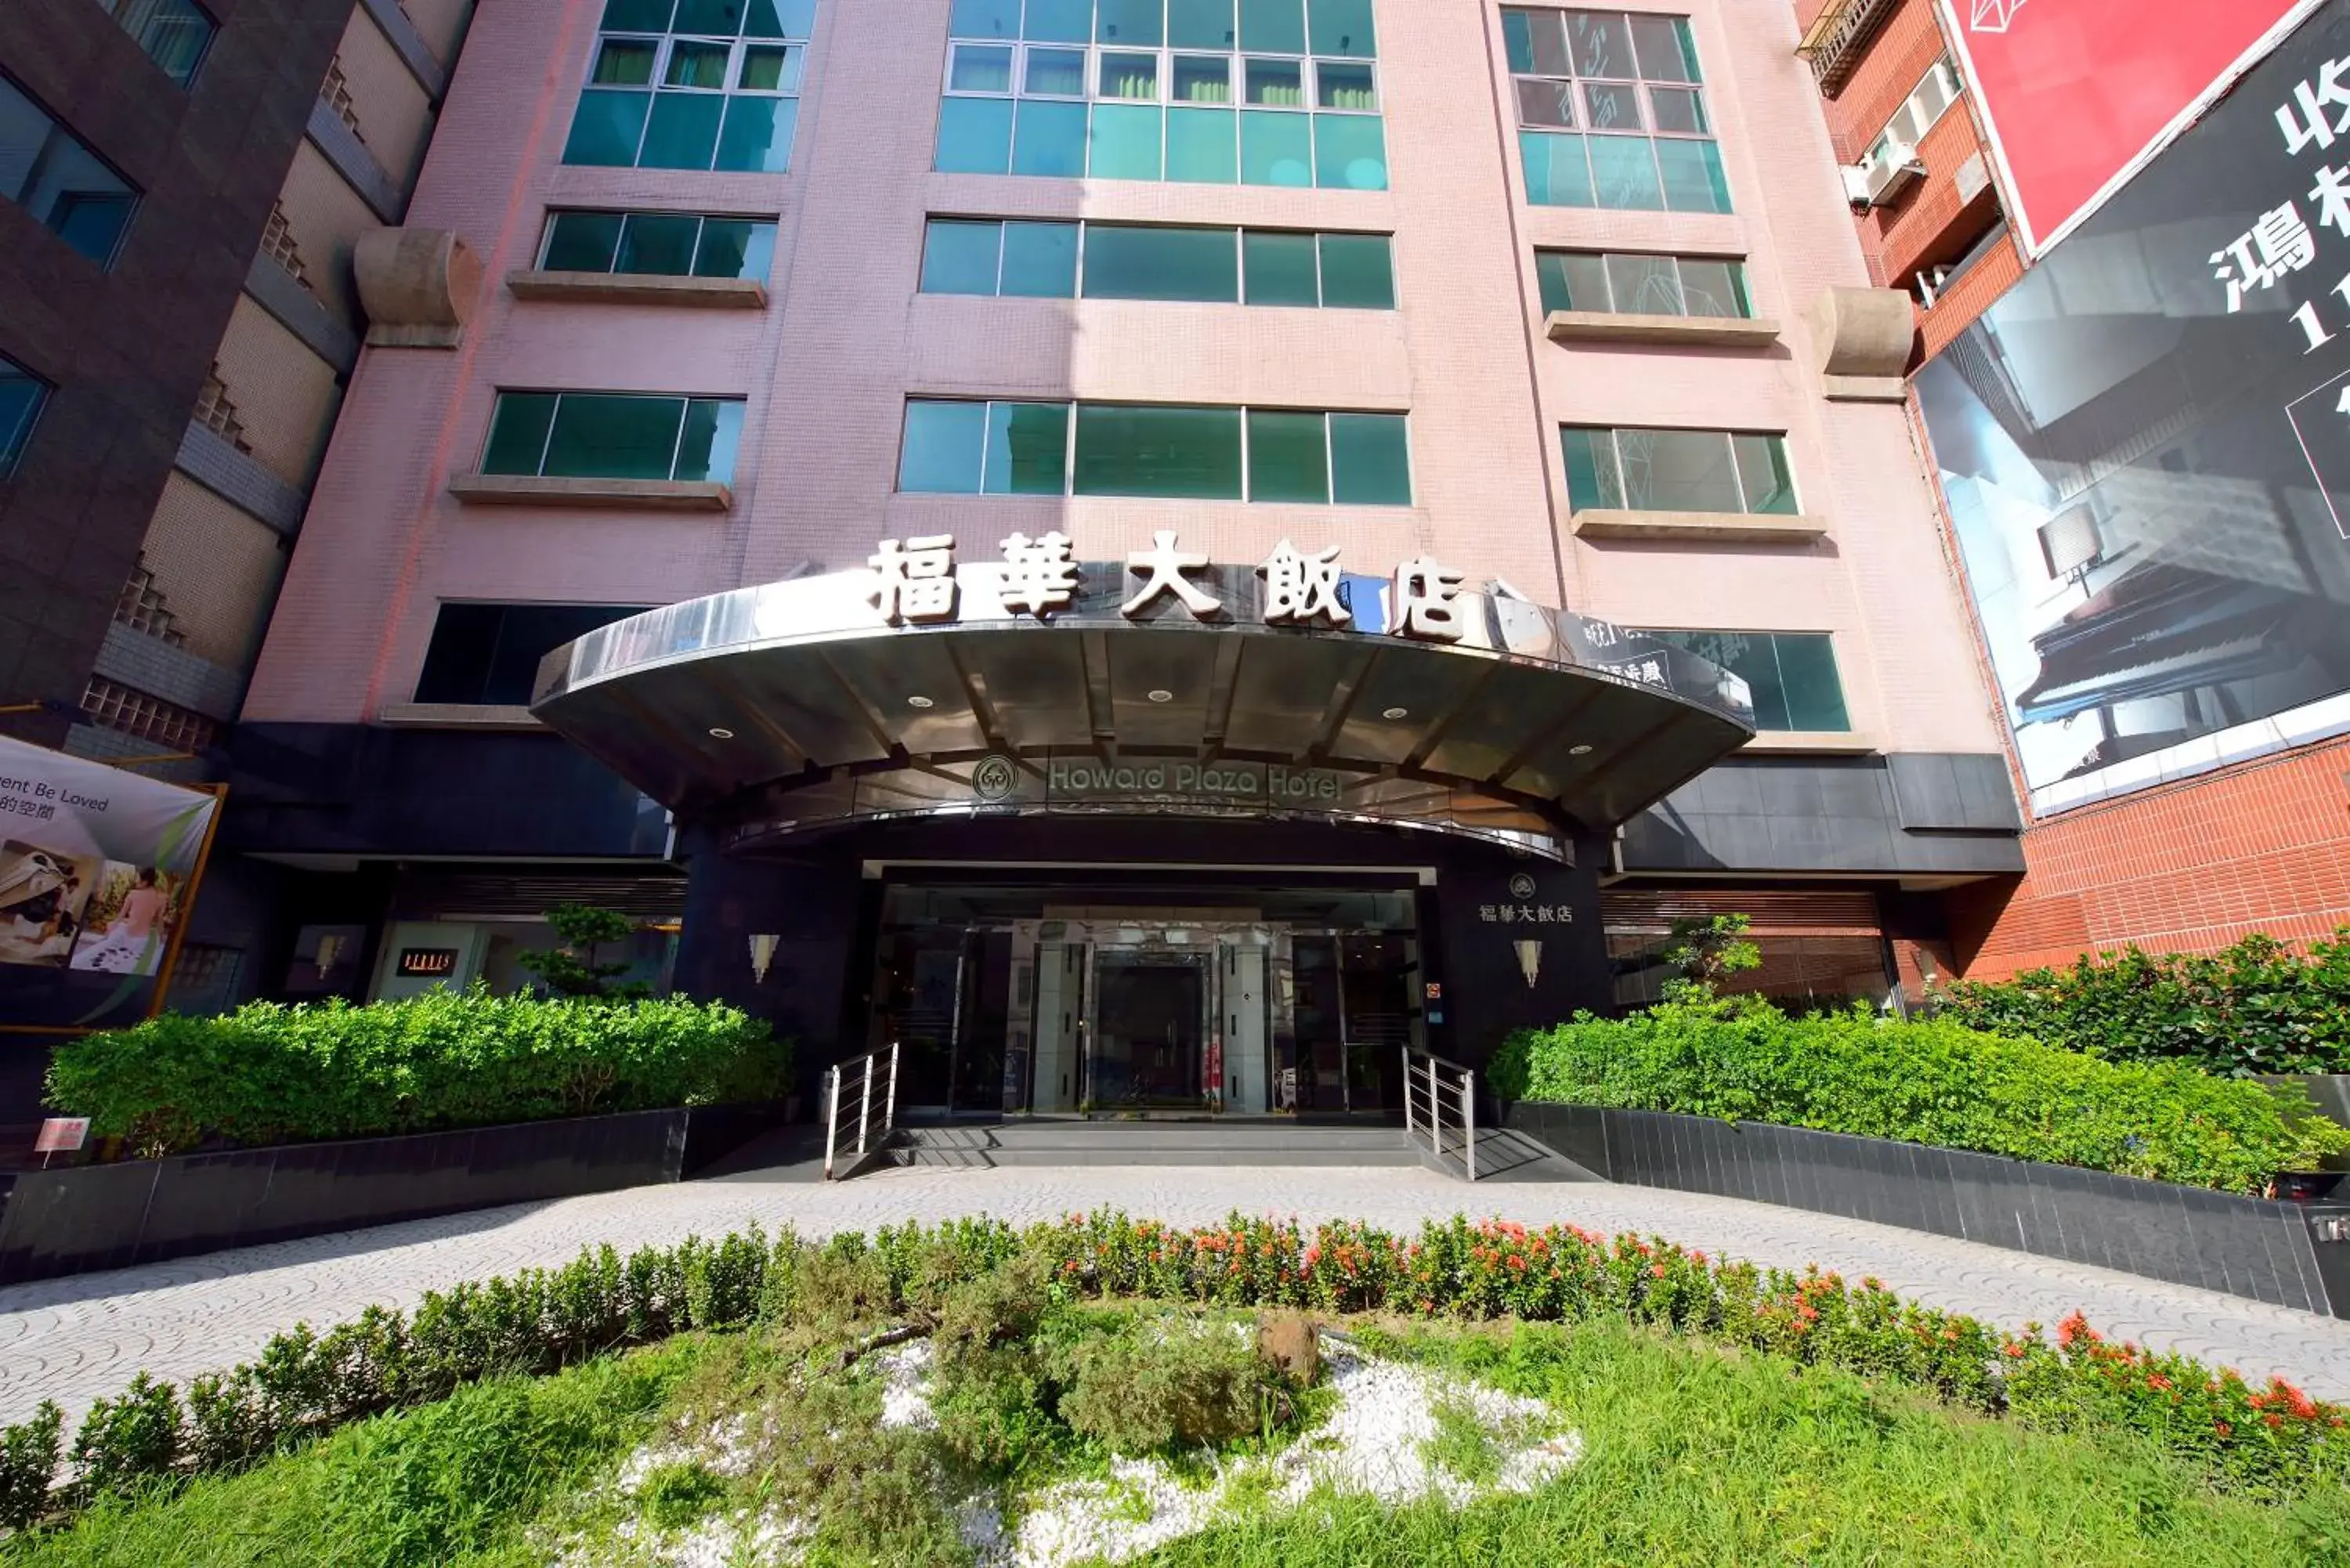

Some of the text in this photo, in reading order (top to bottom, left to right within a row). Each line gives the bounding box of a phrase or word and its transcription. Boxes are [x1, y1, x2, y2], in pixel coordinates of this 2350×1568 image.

[867, 529, 1463, 643] 福華大飯店
[0, 776, 109, 811] ent Be Loved
[1050, 763, 1342, 801] Howard Plaza Hotel
[1479, 905, 1572, 923] 福華大飯店
